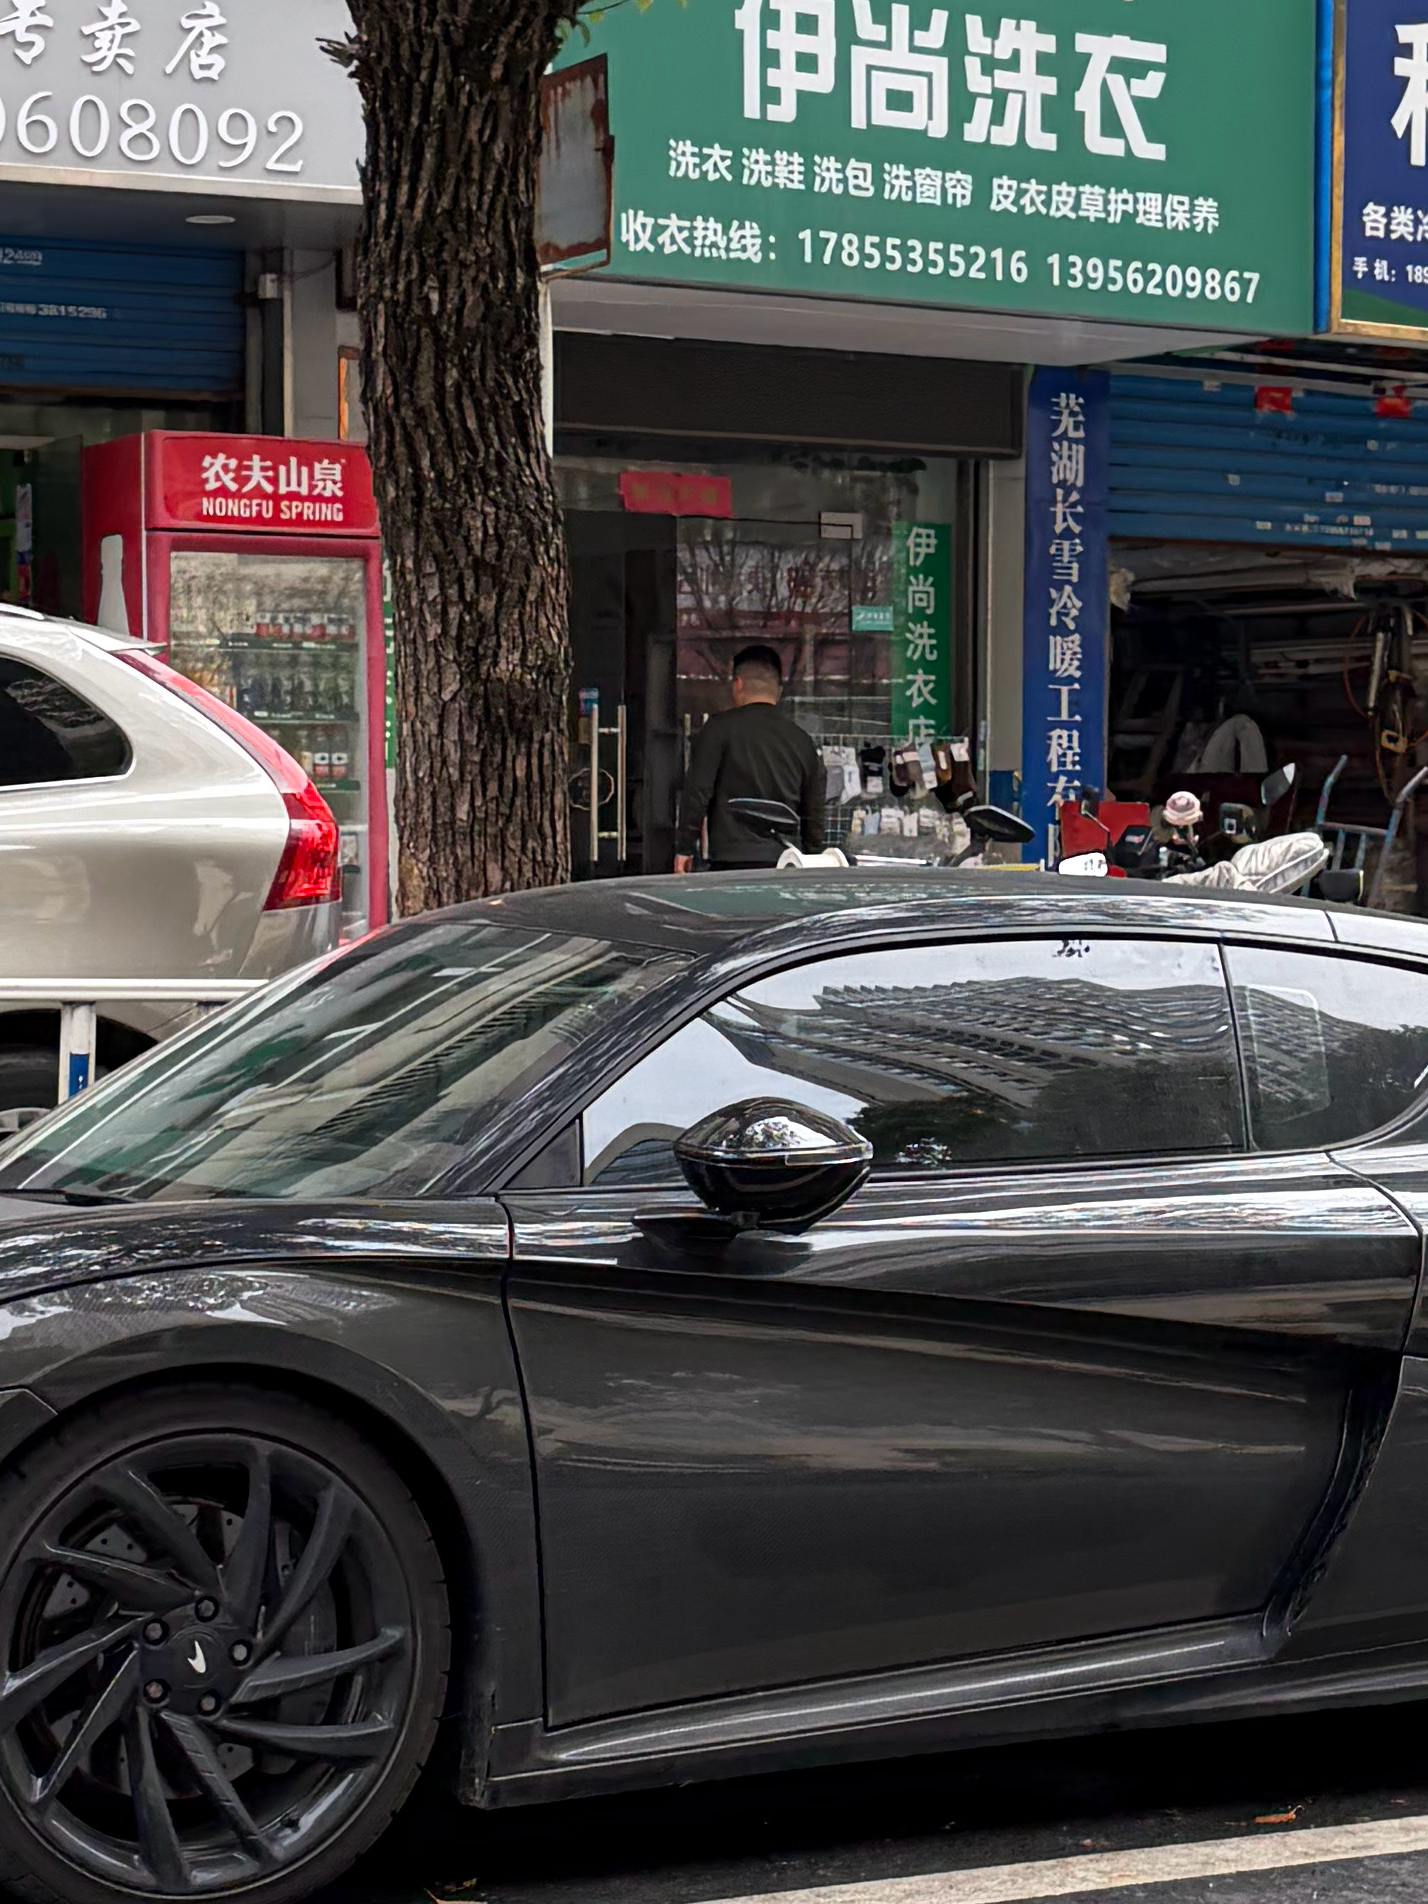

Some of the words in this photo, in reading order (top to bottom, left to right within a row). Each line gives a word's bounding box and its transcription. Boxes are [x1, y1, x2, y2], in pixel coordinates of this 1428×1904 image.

[668, 138, 733, 181] 洗衣
[741, 147, 806, 191] 洗鞋
[813, 154, 875, 197] 洗包
[883, 162, 973, 209] 洗窗帘
[990, 175, 1220, 234] 皮衣皮草护理保养
[620, 208, 776, 264] 收衣热线：
[798, 228, 1029, 284] 17855355216
[1046, 253, 1261, 305] 13956209867
[200, 452, 344, 498] 农夫山泉
[201, 497, 273, 519] NONGFU
[280, 500, 344, 522] SPRING
[904, 525, 939, 747] 伊尚洗衣店
